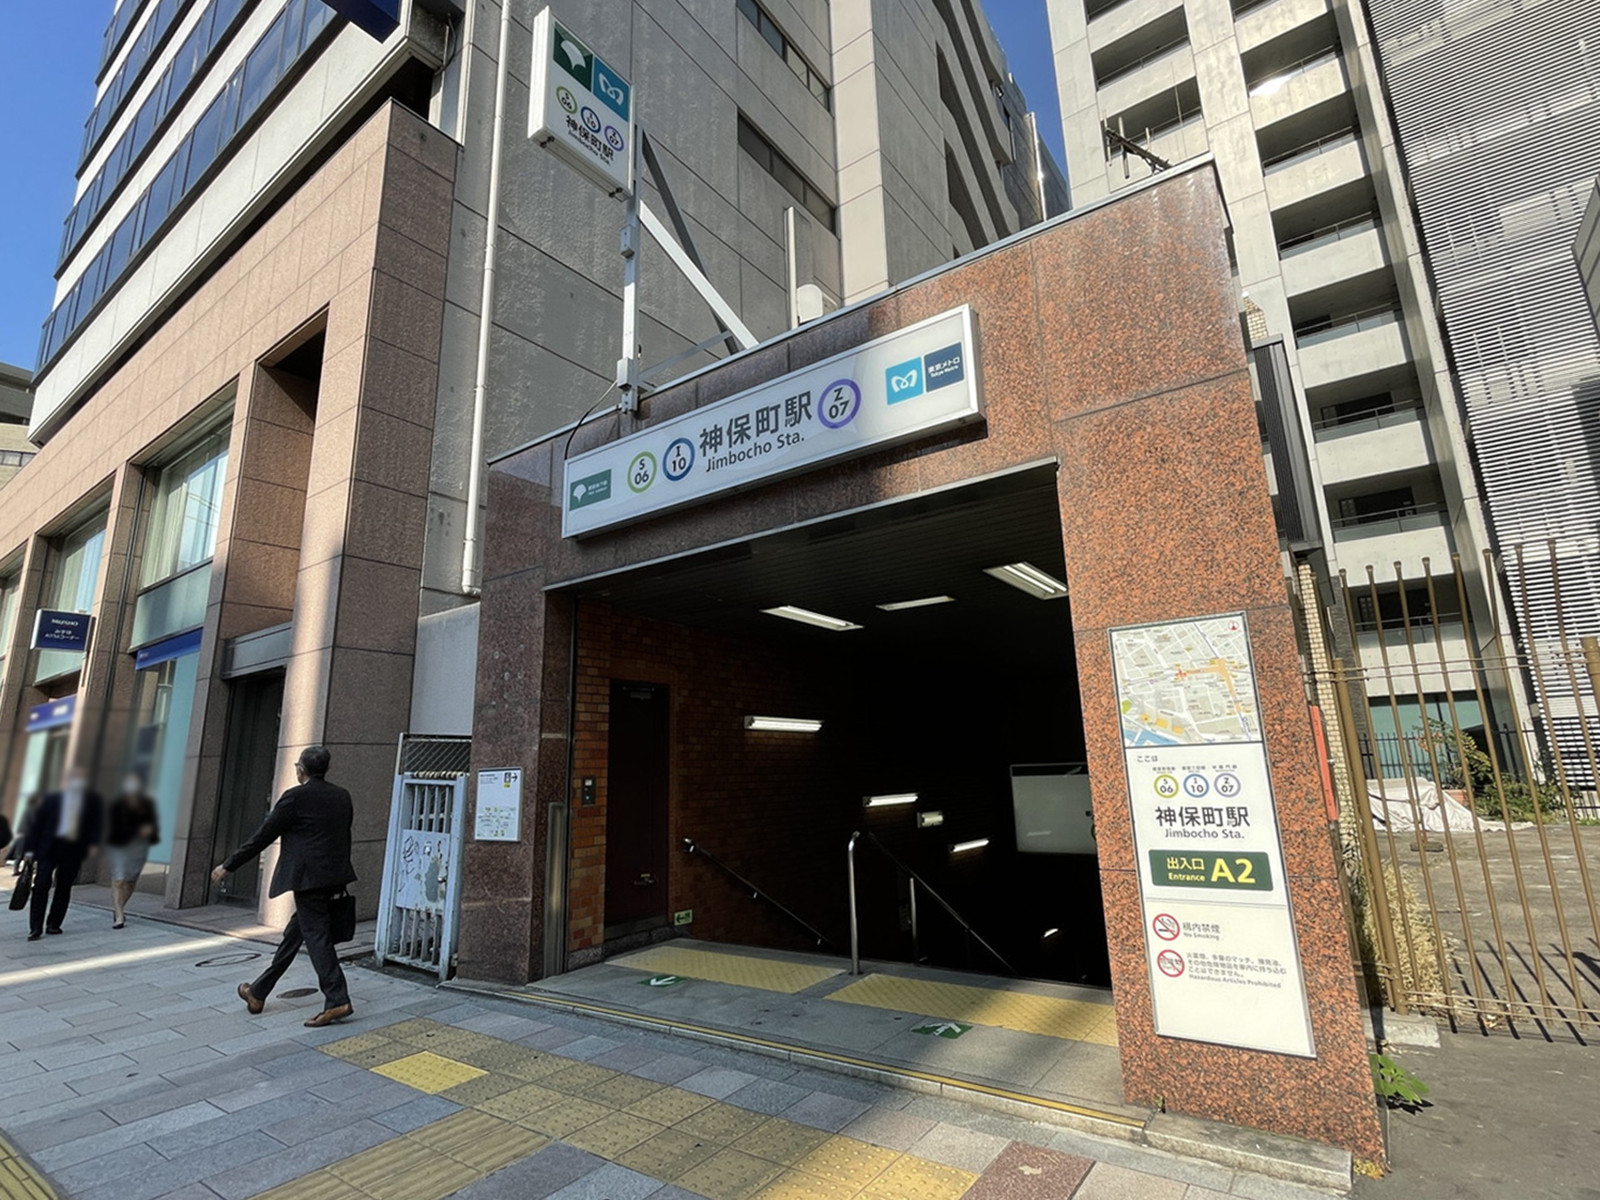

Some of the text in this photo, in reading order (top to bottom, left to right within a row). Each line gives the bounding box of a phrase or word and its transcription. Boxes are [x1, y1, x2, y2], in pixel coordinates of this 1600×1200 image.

[566, 114, 614, 161] 神保町駅
[834, 387, 843, 401] Z
[828, 400, 850, 419] 07
[699, 390, 813, 457] 神保町駅
[676, 445, 681, 458] I
[706, 431, 805, 473] Jimbocho Sta.
[639, 458, 645, 471] S
[672, 458, 686, 472] 10
[634, 470, 649, 485] 06
[1160, 785, 1174, 793] 06
[1191, 784, 1204, 793] 10
[1221, 784, 1234, 793] 07
[1155, 806, 1251, 828] 神保町駅
[1165, 828, 1245, 839] Jimbocho Sta.
[1166, 857, 1205, 870] 出入口
[1168, 872, 1206, 882] Entrance
[1210, 858, 1256, 884] A2
